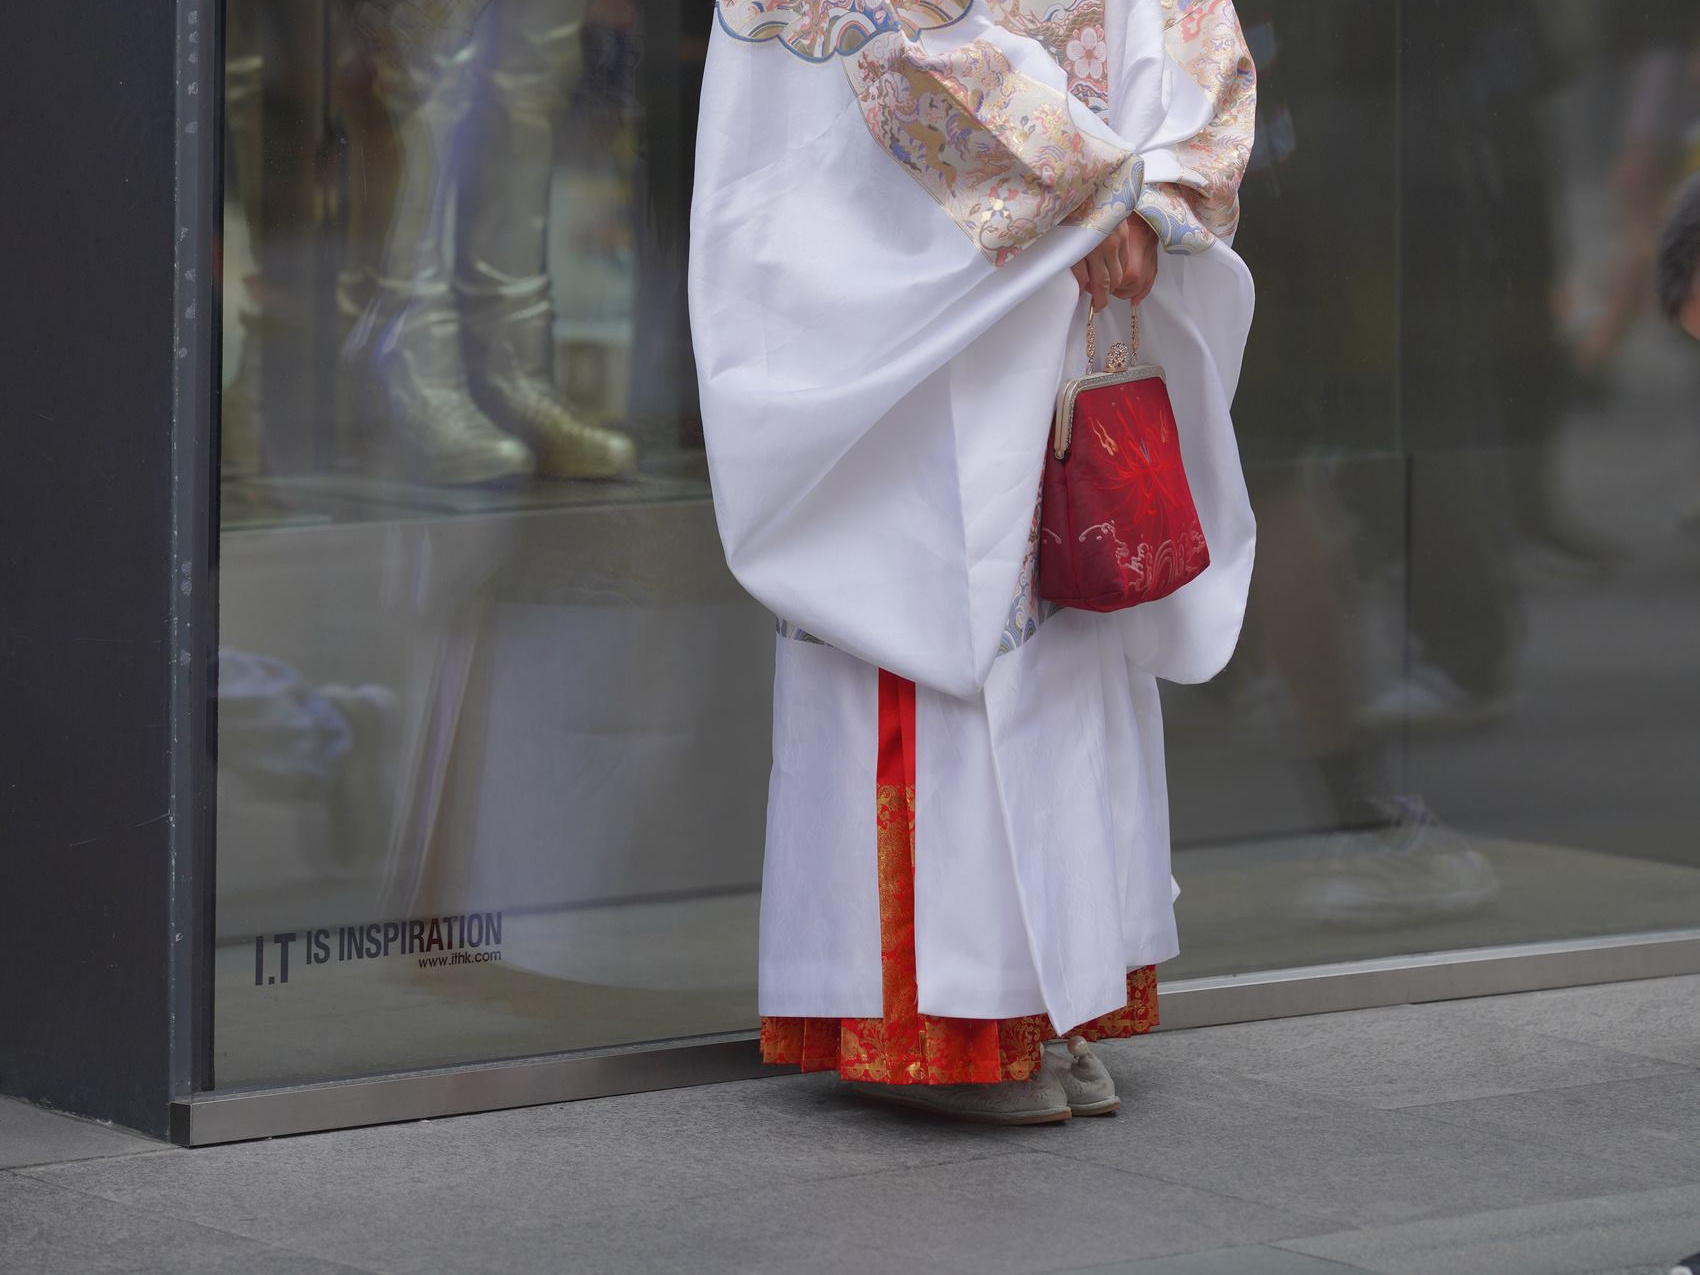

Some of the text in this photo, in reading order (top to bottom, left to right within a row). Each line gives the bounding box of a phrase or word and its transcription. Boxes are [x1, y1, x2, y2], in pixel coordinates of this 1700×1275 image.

[255, 911, 503, 986] I.T IS INSPIRATION
[418, 949, 502, 969] www.ithk.com
